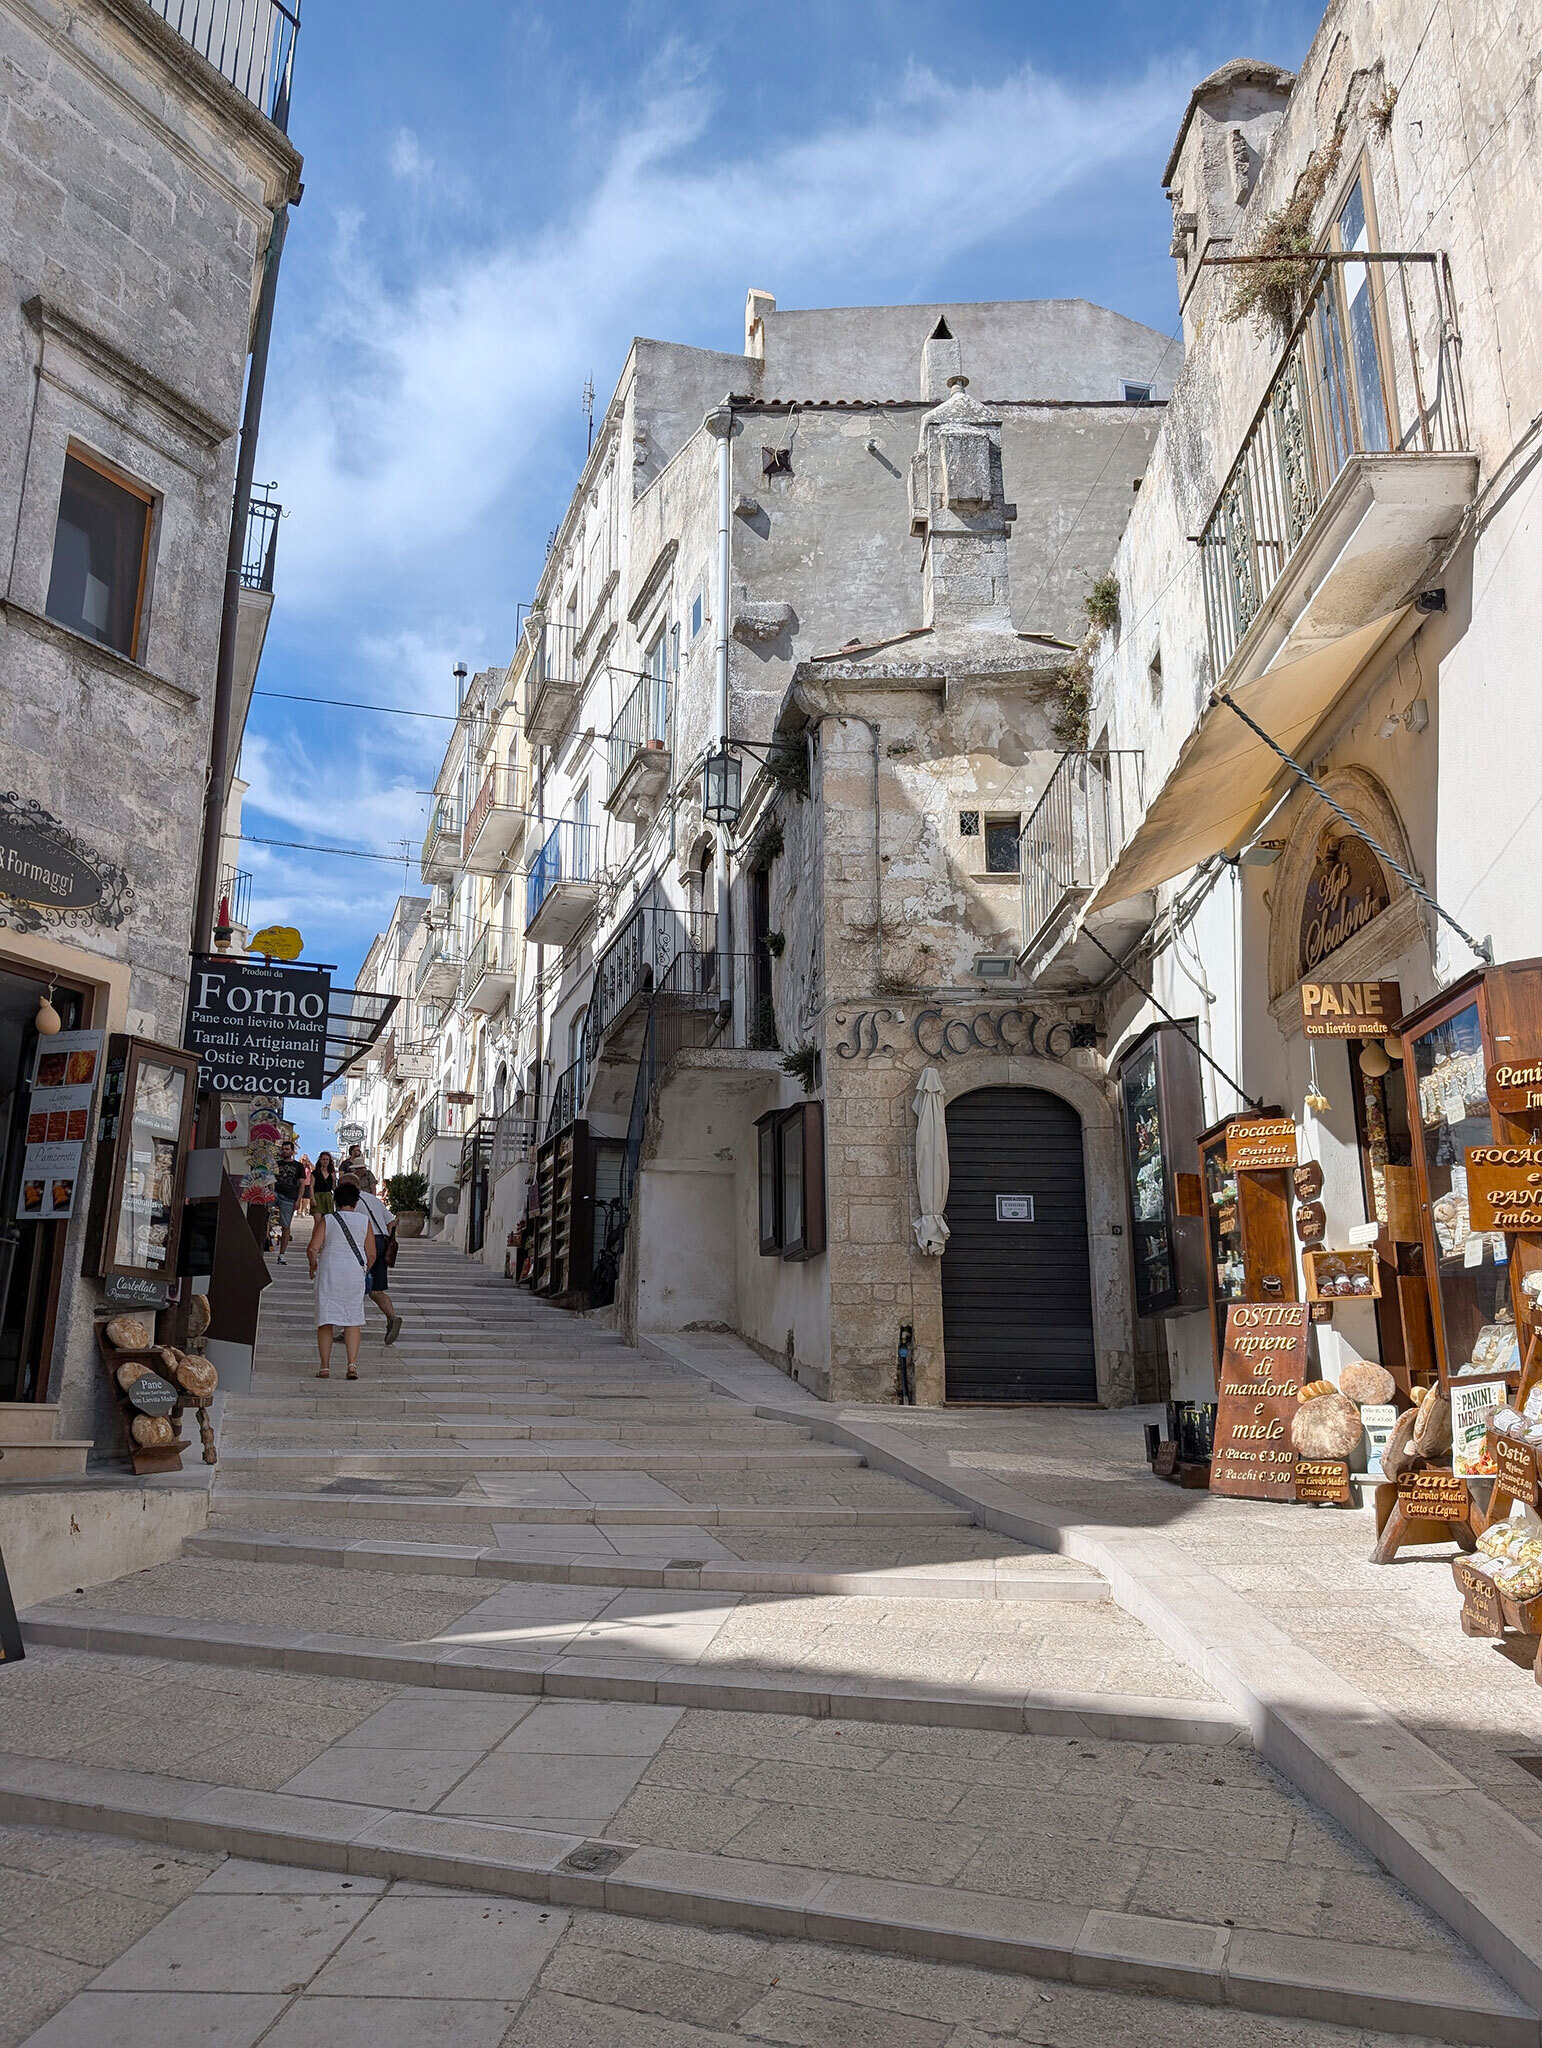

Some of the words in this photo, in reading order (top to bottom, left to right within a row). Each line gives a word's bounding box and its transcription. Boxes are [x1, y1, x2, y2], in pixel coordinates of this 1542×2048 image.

[242, 967, 272, 977] Prodotti
[274, 970, 283, 978] da
[194, 972, 324, 1018] Forno
[1302, 984, 1383, 1015] PANE
[137, 1019, 145, 1034] 4
[191, 1011, 219, 1024] Pane
[223, 1016, 244, 1026] con
[248, 1016, 284, 1029] lievito
[287, 1019, 325, 1033] Madre
[1307, 1024, 1325, 1033] con
[1326, 1021, 1356, 1034] lievito
[1359, 1021, 1388, 1033] madre
[193, 1030, 240, 1046] Taralli
[243, 1034, 320, 1052] Artigianali
[205, 1049, 244, 1065] Ostie
[248, 1053, 305, 1069] Ripiene
[198, 1066, 311, 1095] Focaccia
[1226, 1120, 1296, 1139] Focaccia
[1238, 1144, 1288, 1156] Panini
[1231, 1155, 1297, 1167] Imbottiti
[1527, 1172, 1540, 1182] e
[116, 1276, 157, 1293] Cartellate
[1232, 1307, 1304, 1327] OSTIE
[1234, 1332, 1297, 1357] ripiene
[1253, 1356, 1274, 1376] di
[141, 1380, 162, 1389] Pane
[1225, 1378, 1298, 1396] mandorle
[1462, 1387, 1492, 1411] PANINI
[1254, 1402, 1264, 1416] e
[1232, 1418, 1285, 1440] miele
[1216, 1449, 1223, 1459] 1
[1225, 1449, 1257, 1461] Pacco
[1214, 1468, 1221, 1479] 2
[1225, 1468, 1257, 1482] Pacchi
[1294, 1462, 1343, 1475] Pane
[1306, 1477, 1326, 1486] Lievito
[1327, 1478, 1347, 1486] Madre
[1398, 1472, 1460, 1488] Pane
[1301, 1487, 1317, 1496] Cotto
[1322, 1488, 1341, 1498] Legna
[1399, 1491, 1412, 1499] con
[1412, 1490, 1439, 1501] Lievito
[1440, 1491, 1467, 1501] Madre
[1406, 1503, 1427, 1514] Cotto
[1435, 1505, 1459, 1517] Legna
